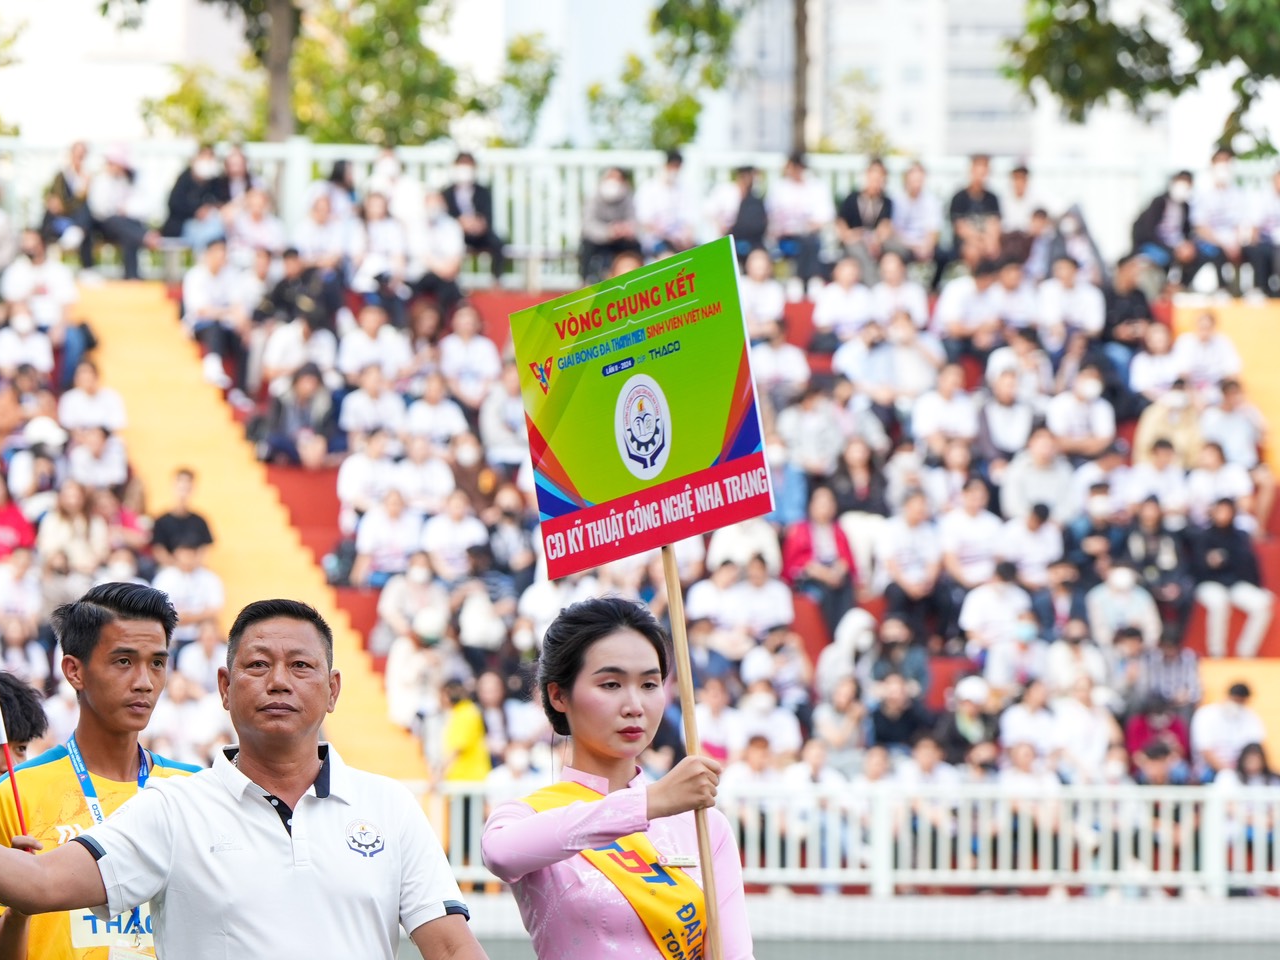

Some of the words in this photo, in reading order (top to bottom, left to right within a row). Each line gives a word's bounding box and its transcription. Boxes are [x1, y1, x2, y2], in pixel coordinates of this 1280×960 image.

[554, 312, 602, 341] VÒNG
[606, 286, 662, 323] CHUNG
[665, 267, 696, 302] KẾT
[646, 323, 664, 340] SINH
[701, 300, 723, 320] NAM
[648, 340, 680, 360] THACO
[546, 534, 566, 561] CĐ
[566, 518, 584, 555] KỸ
[586, 508, 625, 548] THUẬT
[625, 500, 661, 536] CÔNG
[661, 483, 694, 523] NGHỆ
[694, 482, 723, 515] NHA
[723, 466, 769, 505] TRANG
[676, 902, 702, 946] ĐẠI
